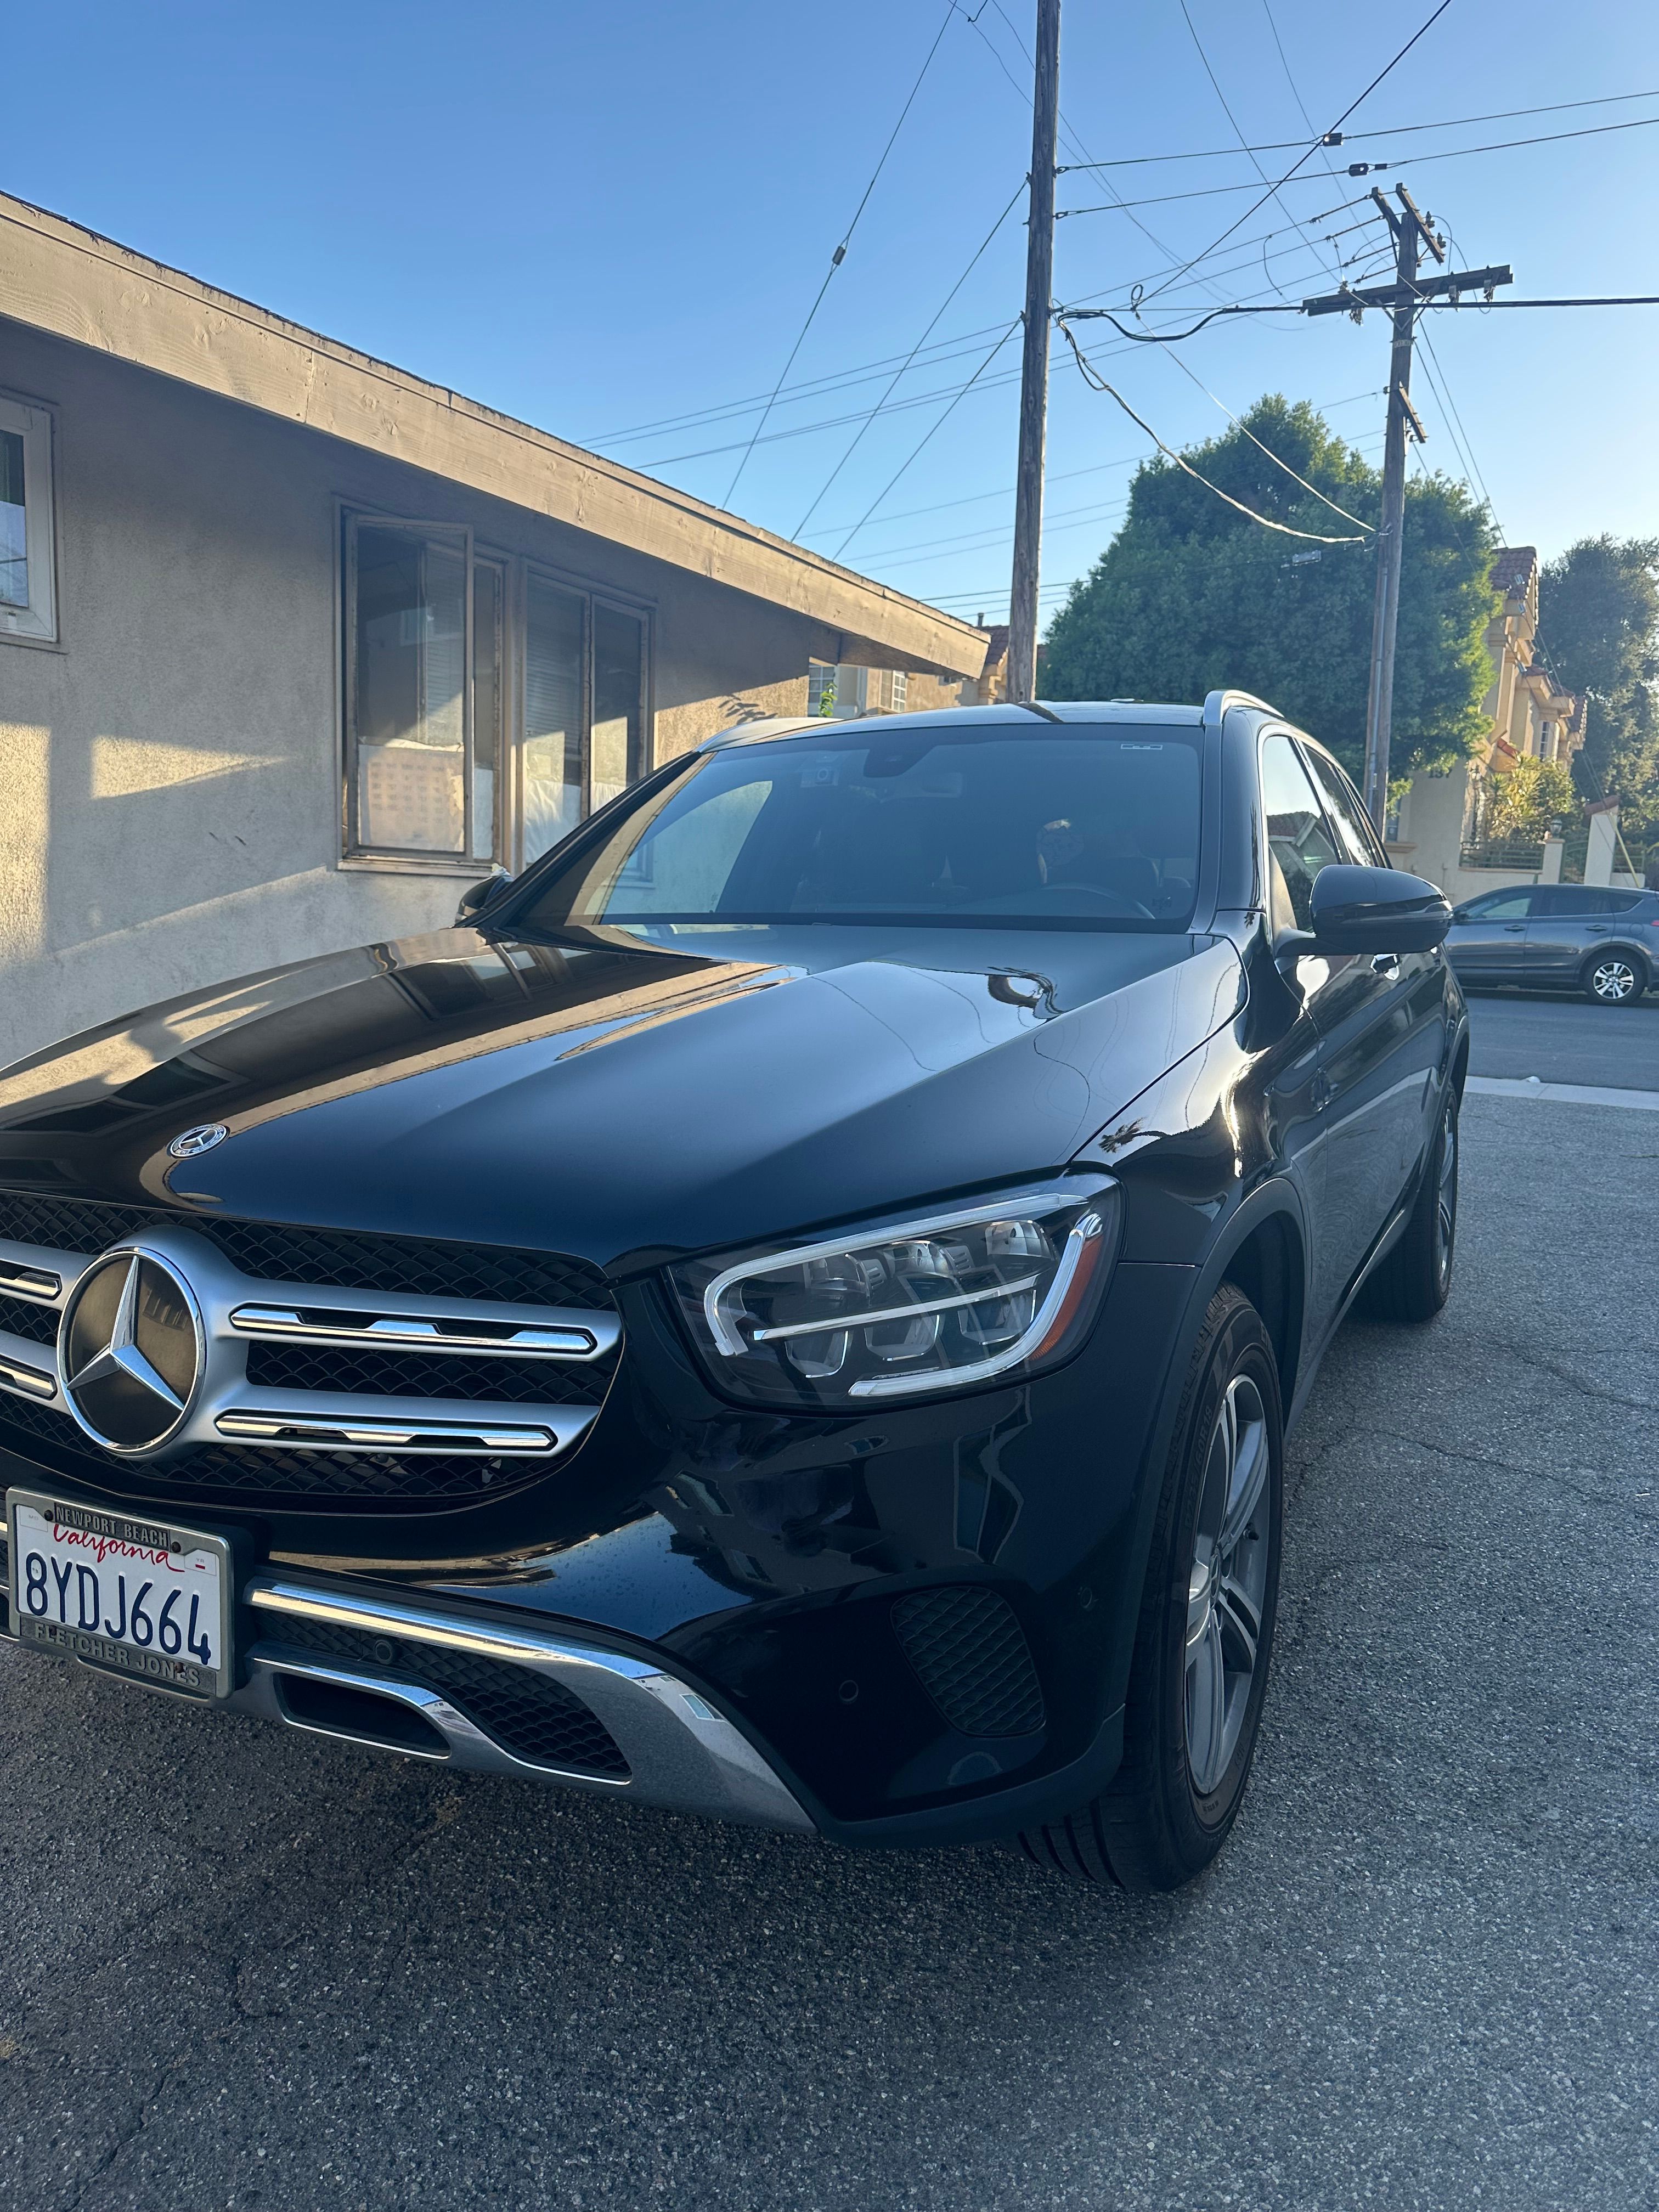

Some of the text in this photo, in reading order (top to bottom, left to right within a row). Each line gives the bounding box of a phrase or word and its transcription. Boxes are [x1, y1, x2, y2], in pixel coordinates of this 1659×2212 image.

[53, 1523, 185, 1572] California
[56, 1506, 169, 1547] NEWPORT BEACH
[26, 1552, 211, 1665] 8YDJ664
[35, 1622, 200, 1686] FLETCHER JONES
